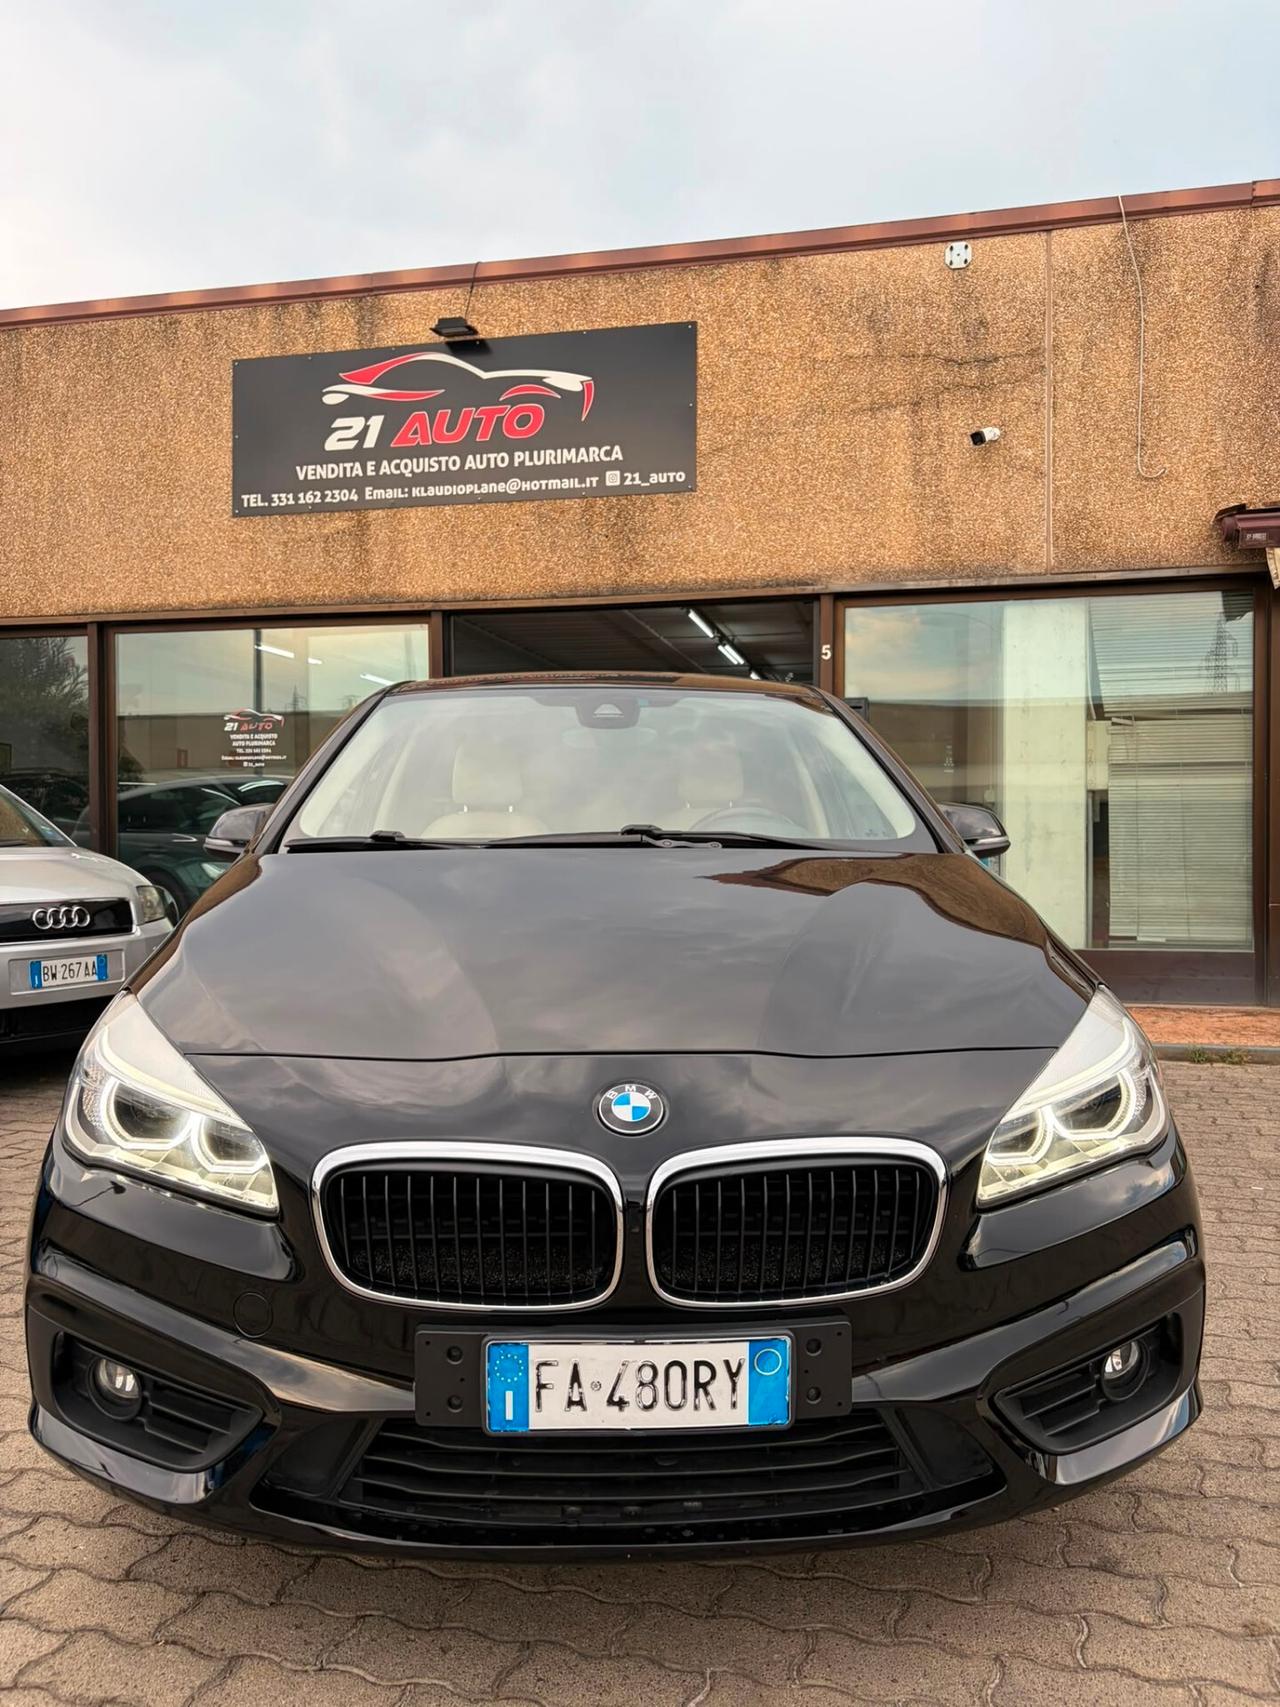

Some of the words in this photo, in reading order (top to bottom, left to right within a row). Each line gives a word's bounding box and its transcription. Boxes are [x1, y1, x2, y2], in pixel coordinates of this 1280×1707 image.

[324, 414, 384, 452] 21
[390, 403, 545, 448] AUTO
[296, 461, 363, 480] VENDITA
[366, 460, 376, 476] E
[379, 456, 461, 477] ACQUISTO
[464, 452, 509, 470] AUTO
[513, 445, 624, 467] PLURIMARCA
[241, 493, 269, 507] TEL.
[271, 493, 295, 507] 331
[298, 491, 322, 504] 162
[324, 488, 359, 503] 2304
[821, 644, 832, 660] 5
[224, 722, 239, 731] 21
[240, 722, 273, 731] AUTO
[43, 964, 57, 982] BW
[61, 961, 82, 980] 267
[84, 961, 97, 977] AA
[606, 1085, 658, 1099] BMW
[535, 1359, 588, 1412] FA
[606, 1357, 746, 1412] 480RY
